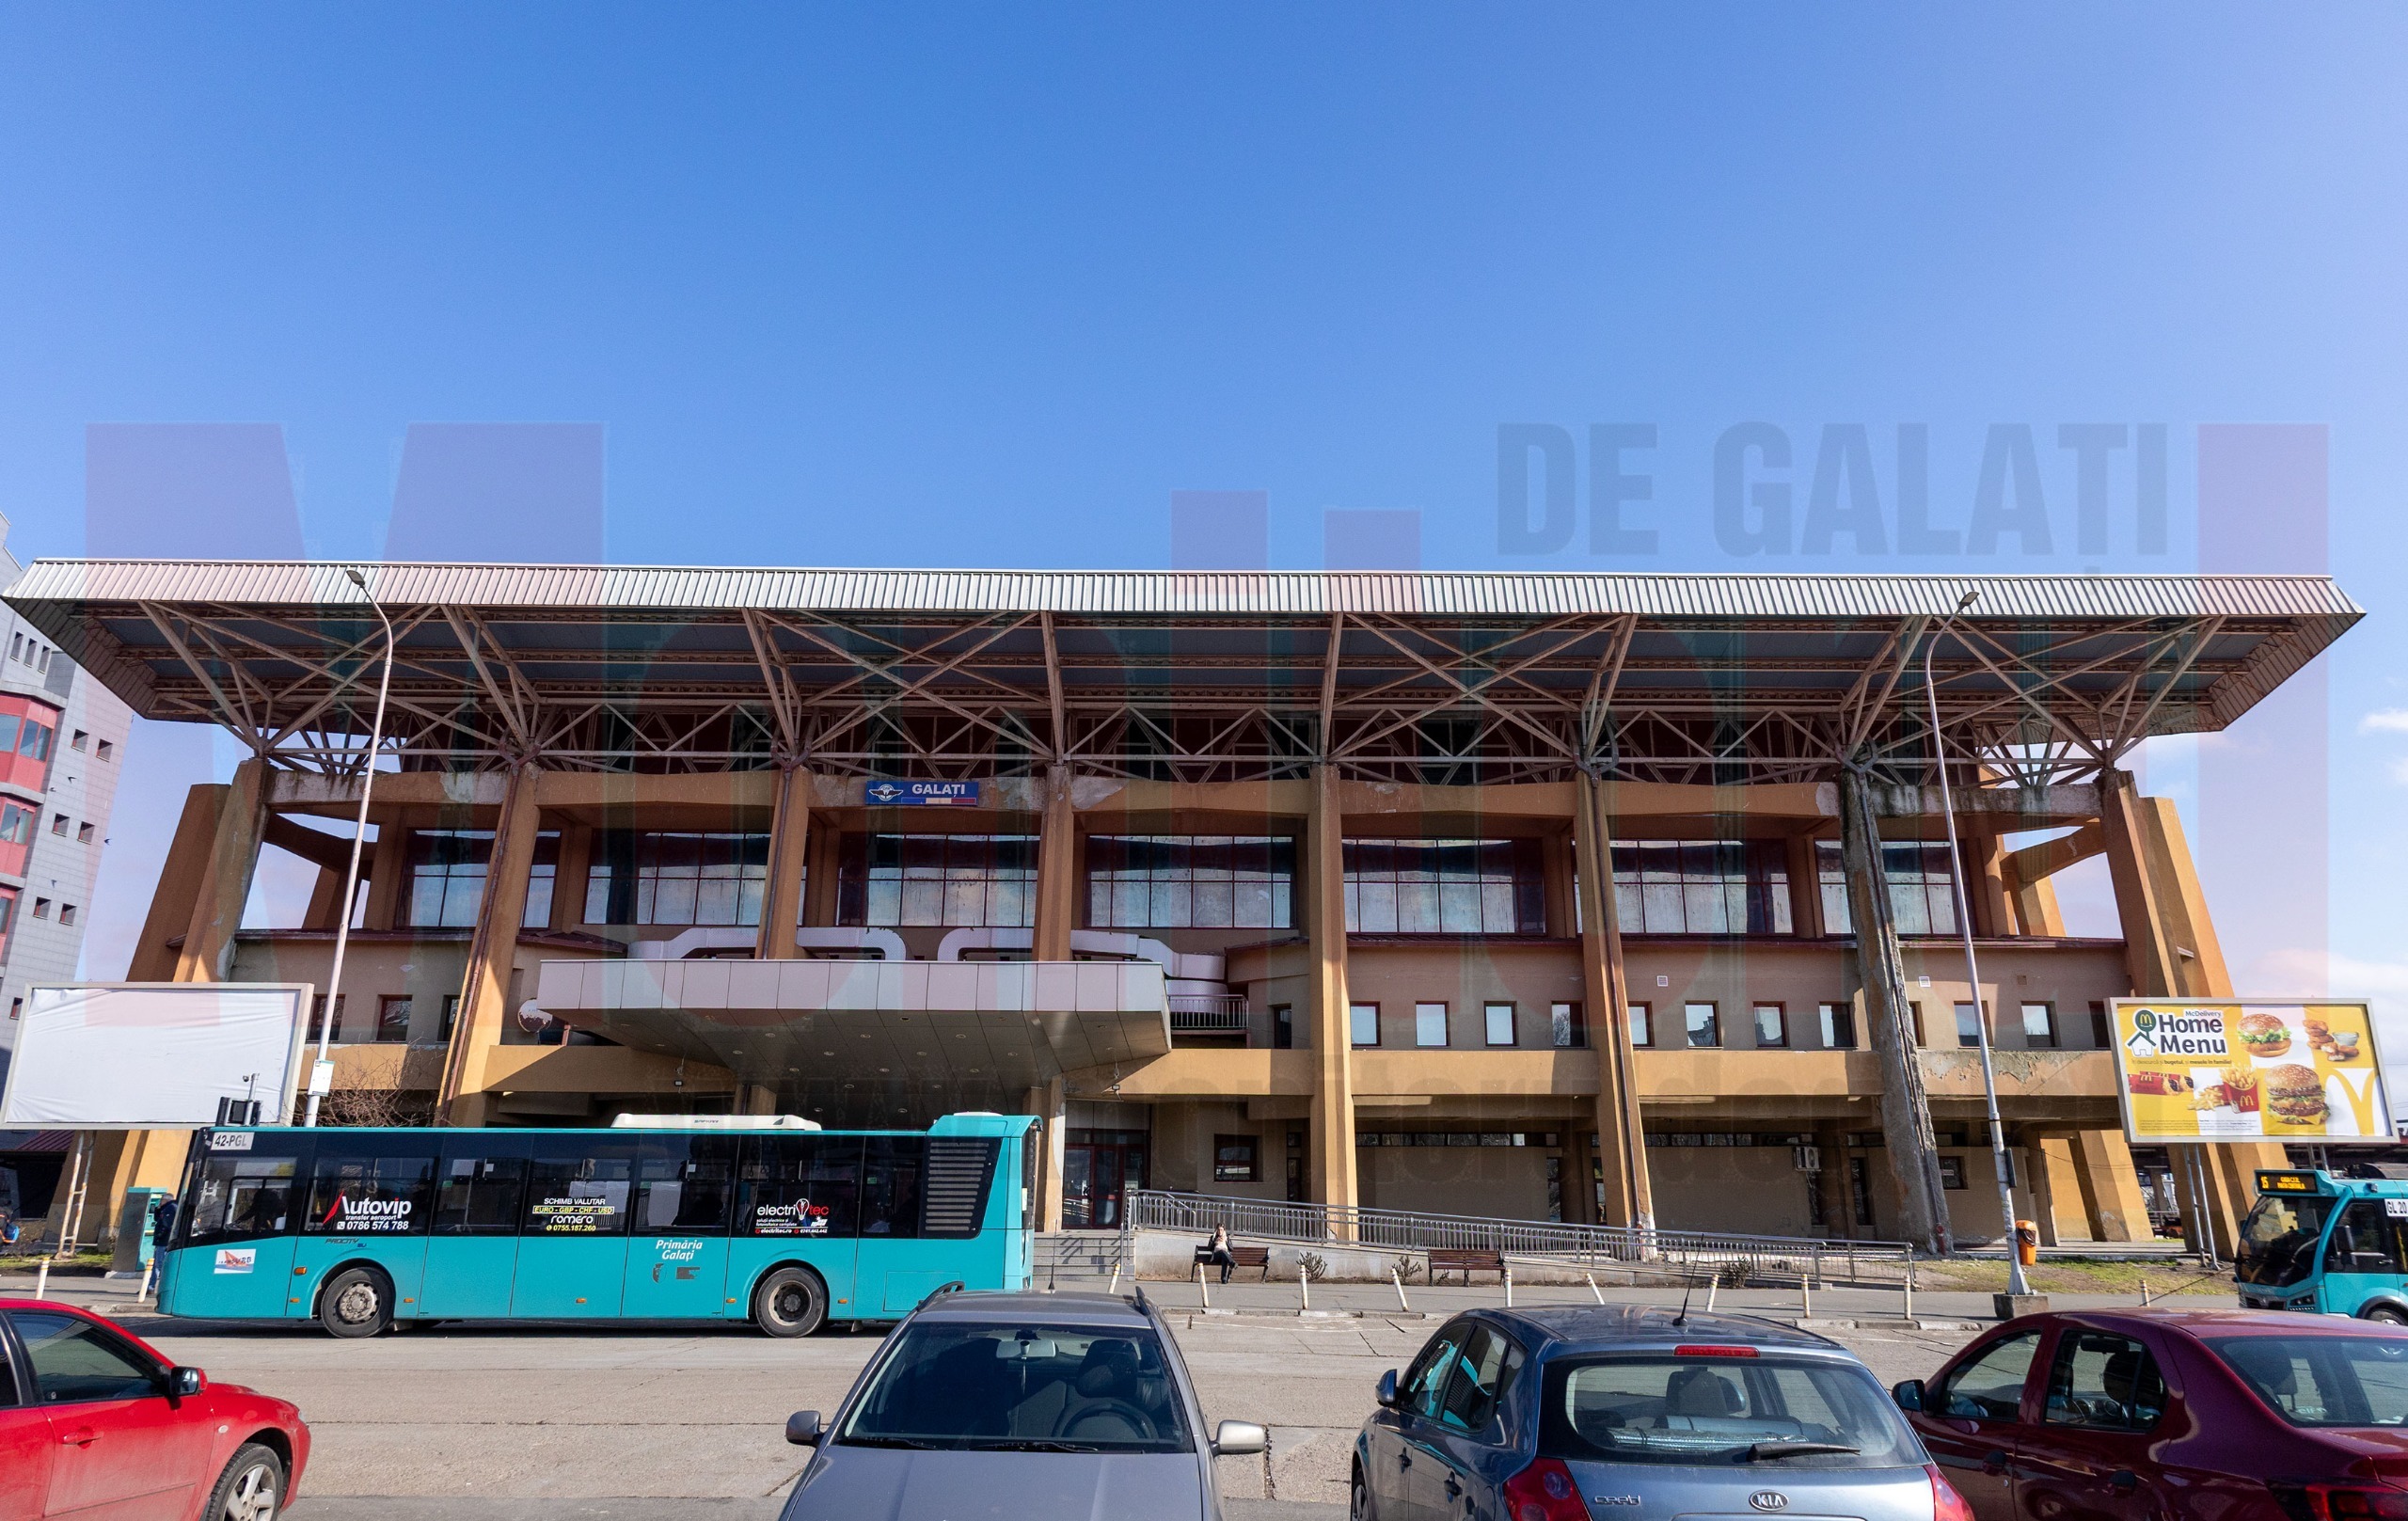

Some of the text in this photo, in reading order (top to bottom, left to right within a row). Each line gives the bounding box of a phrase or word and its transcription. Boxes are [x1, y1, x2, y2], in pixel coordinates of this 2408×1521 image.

[911, 784, 966, 798] GALAȚI
[2185, 1009, 2222, 1018] McDelivery
[2158, 1014, 2223, 1033] Home
[2160, 1035, 2226, 1054] Menu
[214, 1134, 247, 1148] 42-PGL
[323, 1190, 412, 1225] Autovip
[2386, 1200, 2398, 1214] GL
[346, 1220, 409, 1230] 0786 574 788
[655, 1239, 703, 1250] Primăria
[661, 1249, 695, 1262] Galați
[1755, 1493, 1784, 1507] KIA
